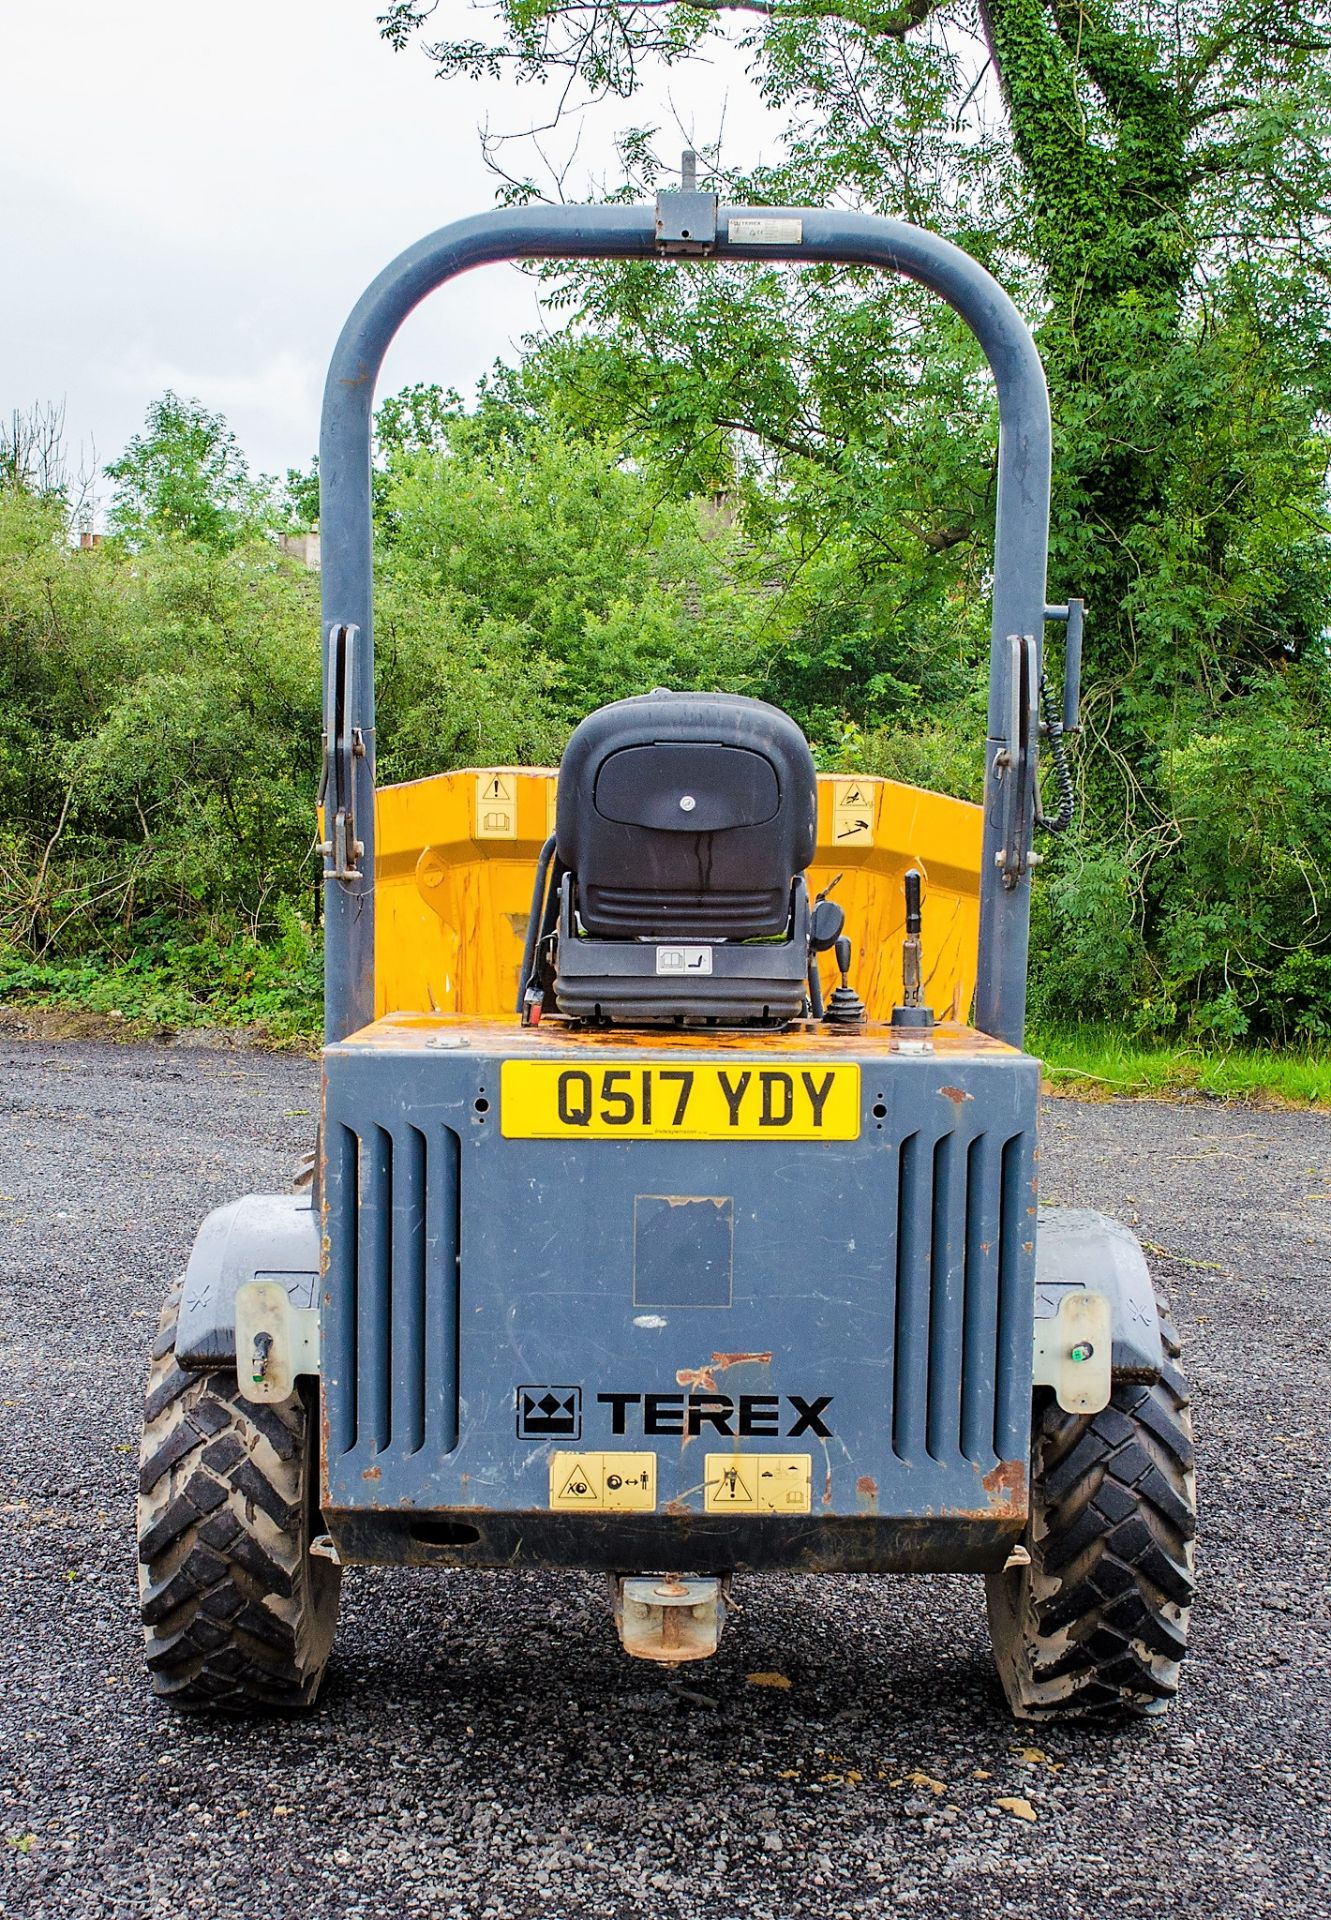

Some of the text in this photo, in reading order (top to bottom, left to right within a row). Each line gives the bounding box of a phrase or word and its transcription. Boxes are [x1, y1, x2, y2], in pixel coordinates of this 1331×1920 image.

[558, 1070, 835, 1126] Q517 YDY
[597, 1393, 834, 1437] TEREX
